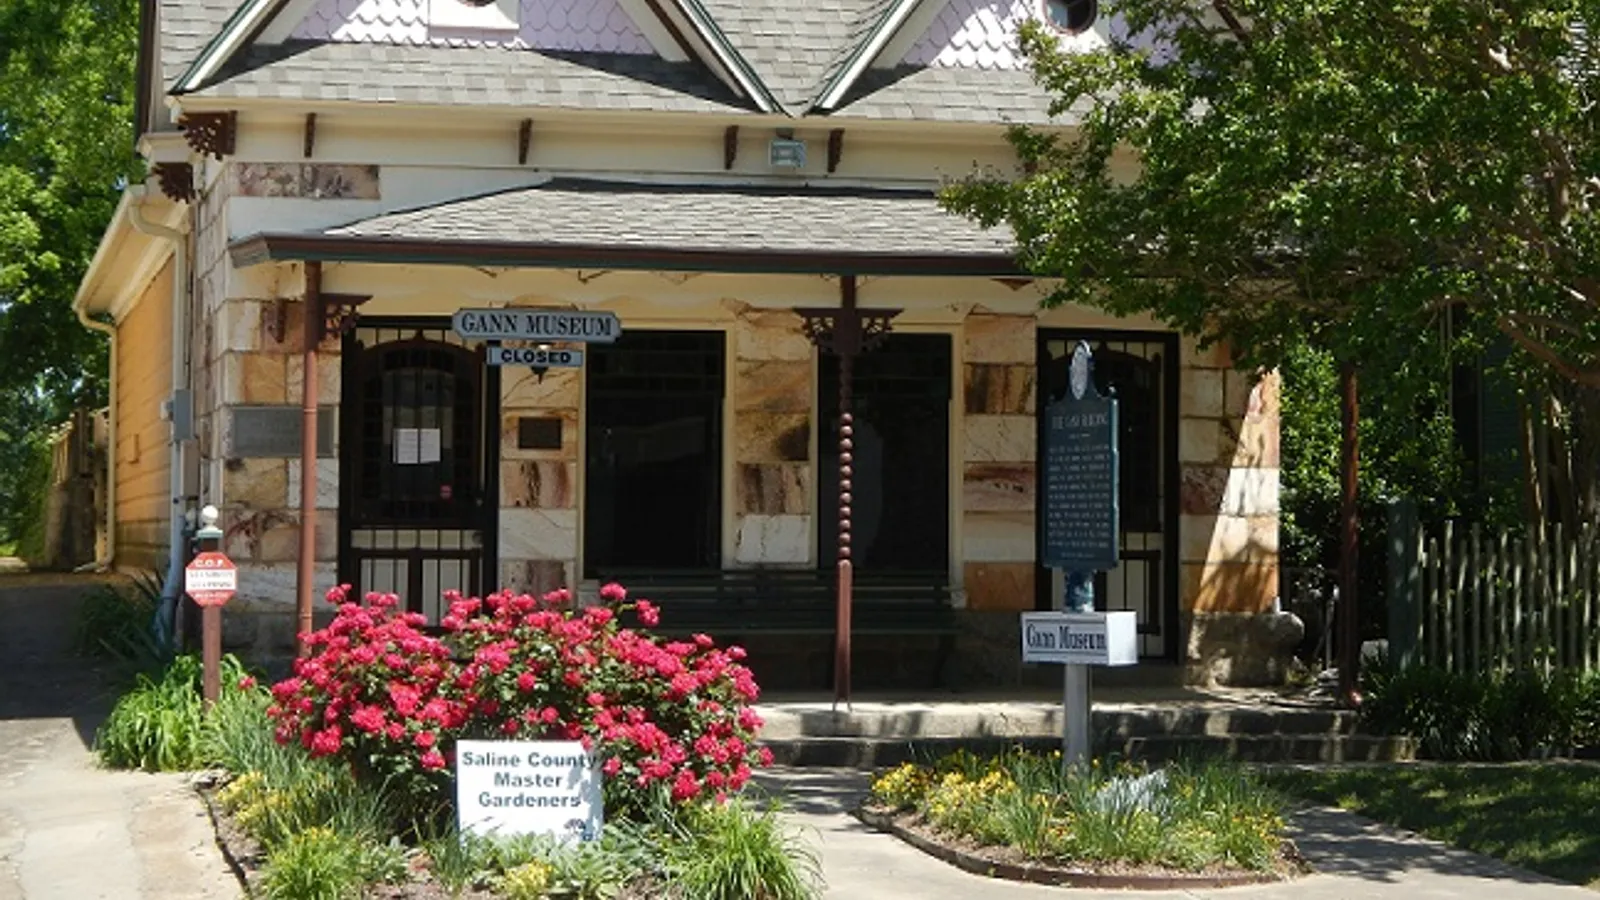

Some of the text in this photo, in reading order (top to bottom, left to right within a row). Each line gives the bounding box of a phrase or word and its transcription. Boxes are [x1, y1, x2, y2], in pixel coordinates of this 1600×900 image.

[461, 312, 612, 336] GANN MUSEUM
[501, 349, 572, 364] CLOSED
[1059, 625, 1107, 650] Museum
[462, 751, 597, 770] Saline County
[494, 772, 563, 787] Master
[478, 791, 581, 808] Gardeners
